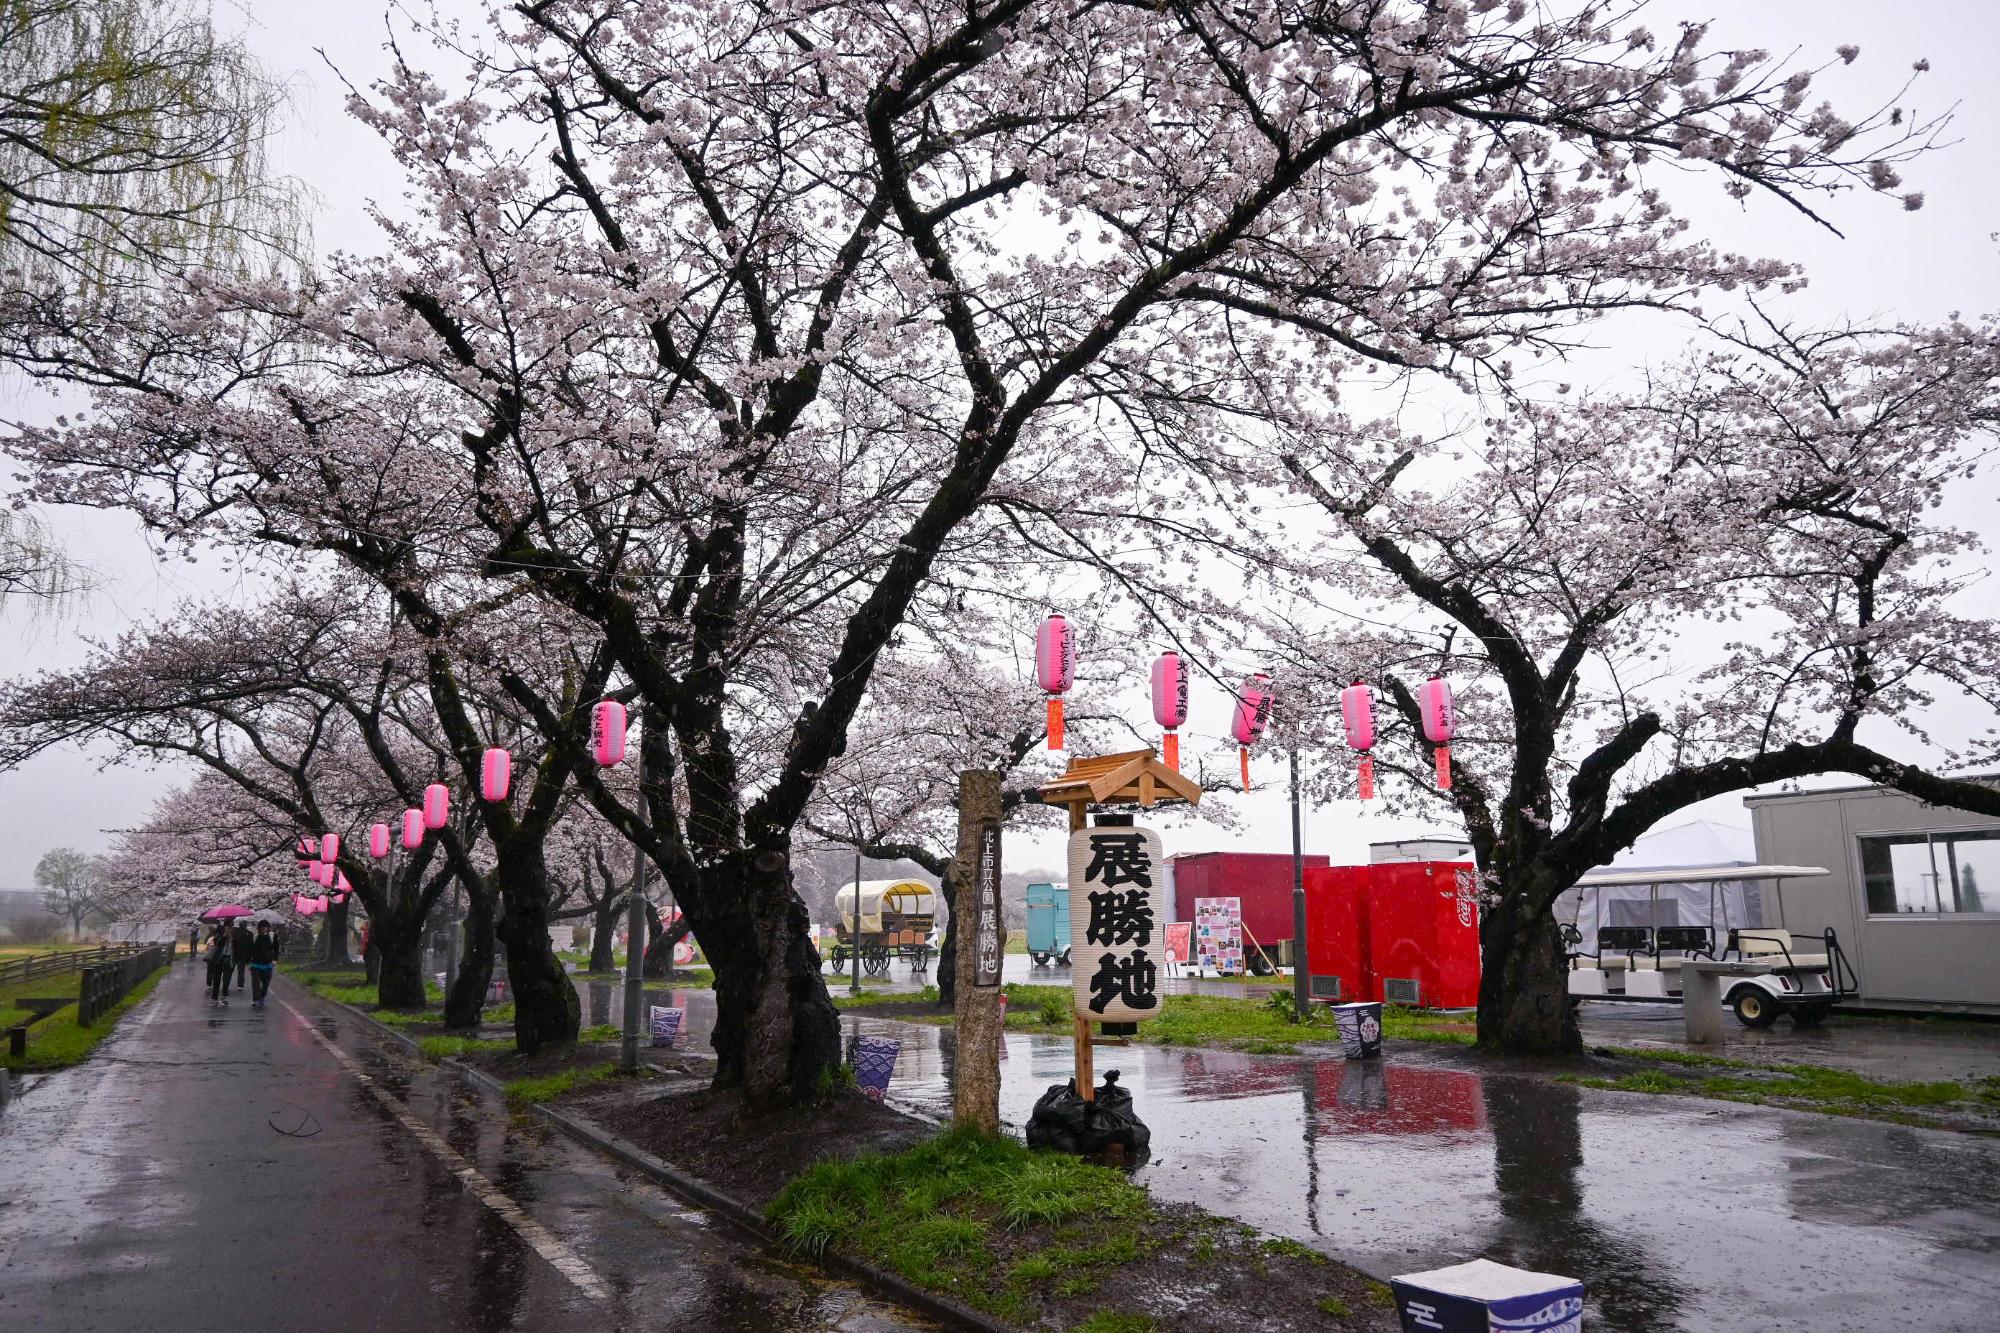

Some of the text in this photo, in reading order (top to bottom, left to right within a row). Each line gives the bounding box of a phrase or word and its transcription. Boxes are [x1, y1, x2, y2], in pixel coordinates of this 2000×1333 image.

[979, 830, 998, 974] 北上市立公園 展勝地
[1085, 832, 1158, 1015] 展勝地
